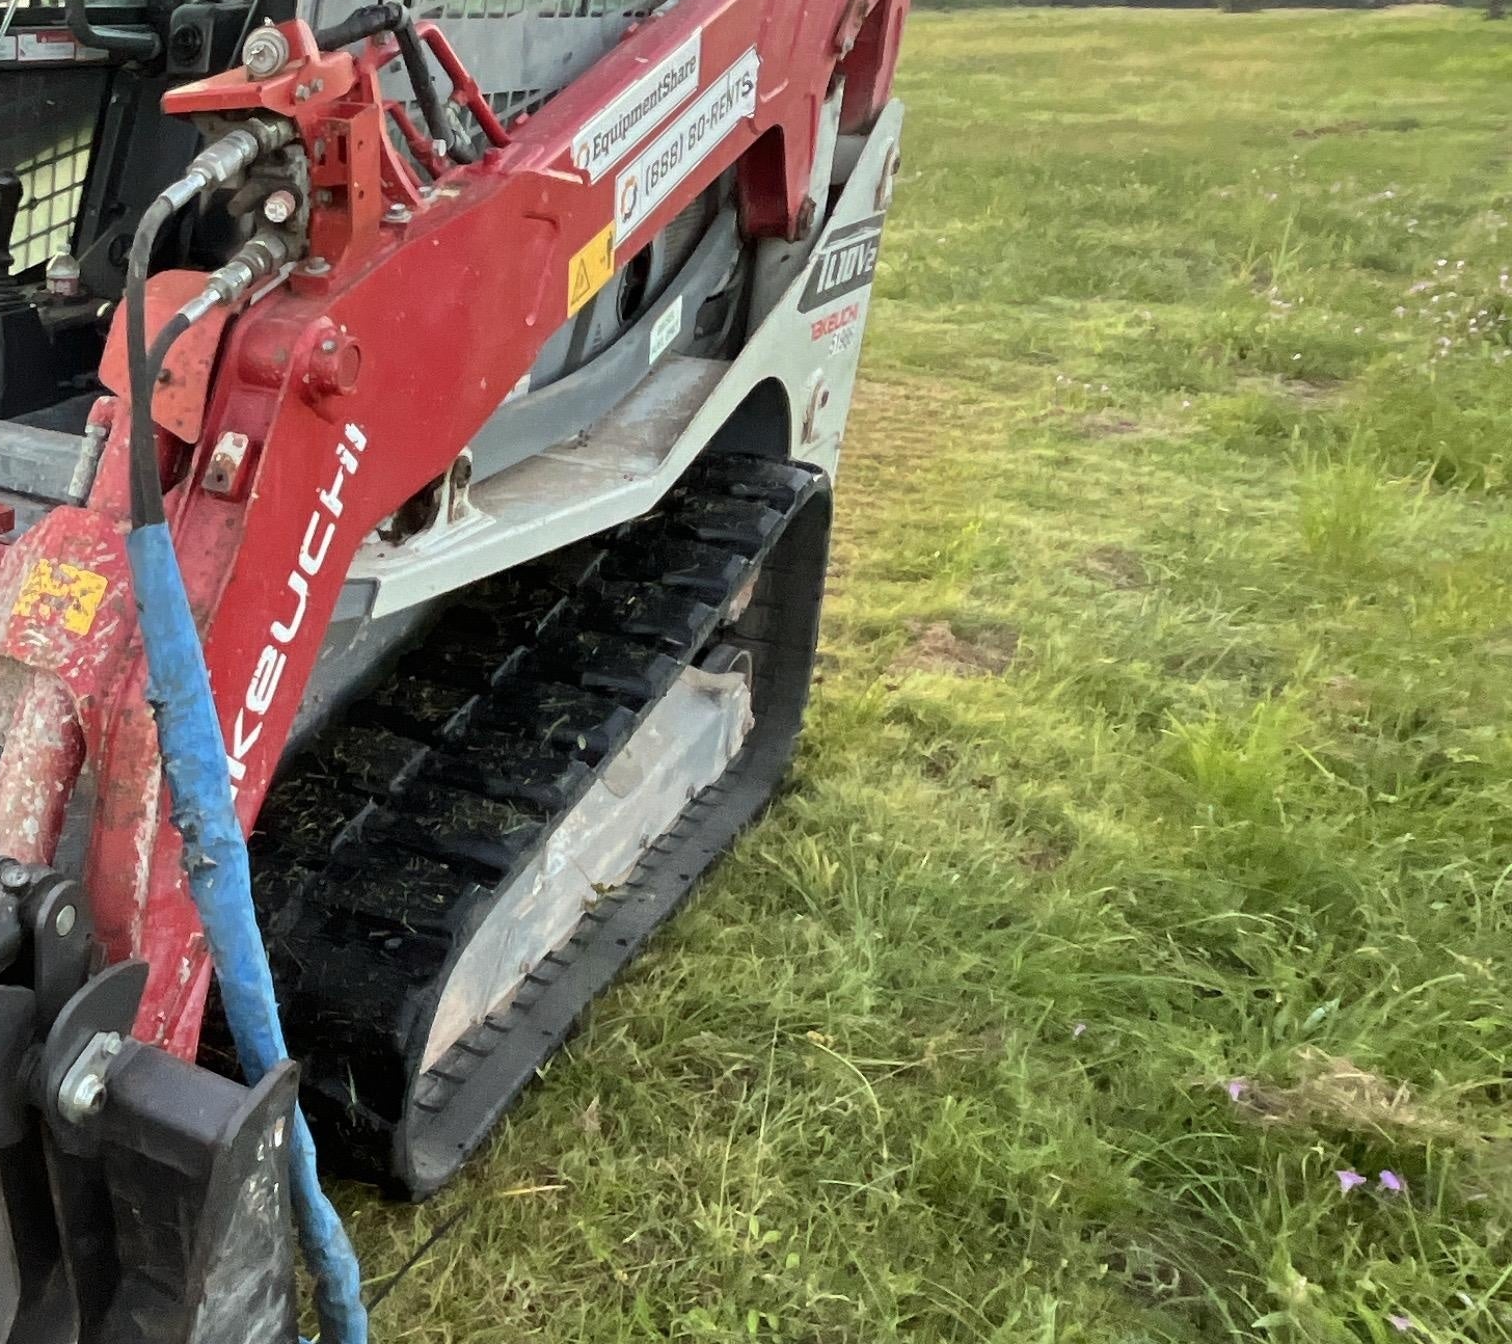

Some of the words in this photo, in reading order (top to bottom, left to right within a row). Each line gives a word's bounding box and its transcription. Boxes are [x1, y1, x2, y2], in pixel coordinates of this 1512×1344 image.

[592, 55, 697, 161] EquipmentShare
[644, 133, 684, 196] (888)
[229, 422, 368, 802] KEUCHI
